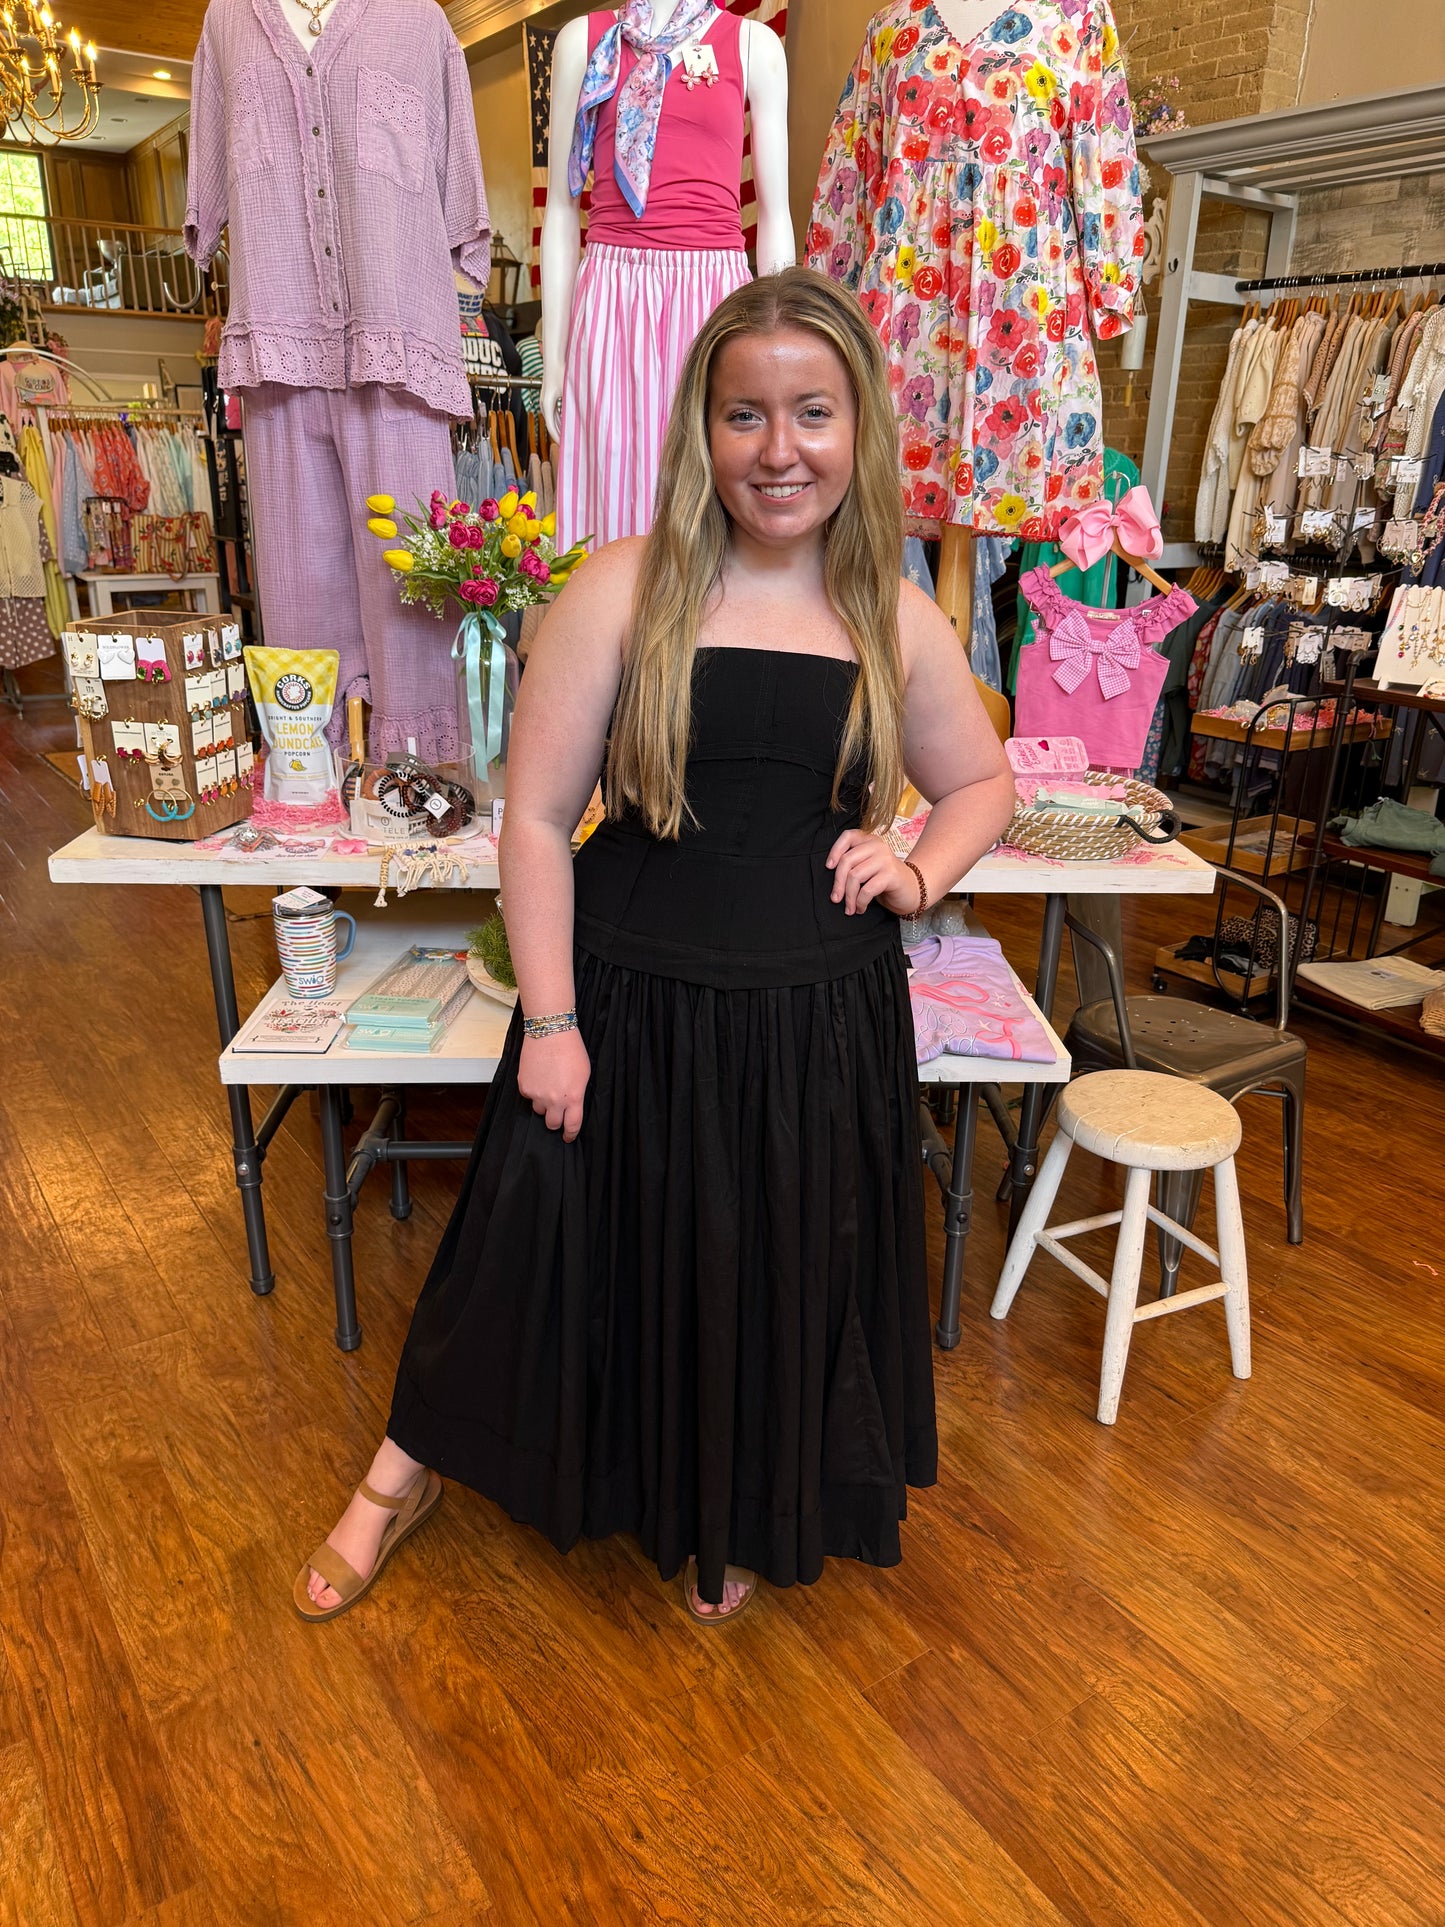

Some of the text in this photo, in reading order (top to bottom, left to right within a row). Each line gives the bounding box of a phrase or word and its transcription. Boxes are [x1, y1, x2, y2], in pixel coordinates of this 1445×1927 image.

[462, 337, 506, 369] DUC
[276, 674, 311, 690] CORKS
[275, 723, 314, 735] LEMON
[299, 975, 324, 985] swig
